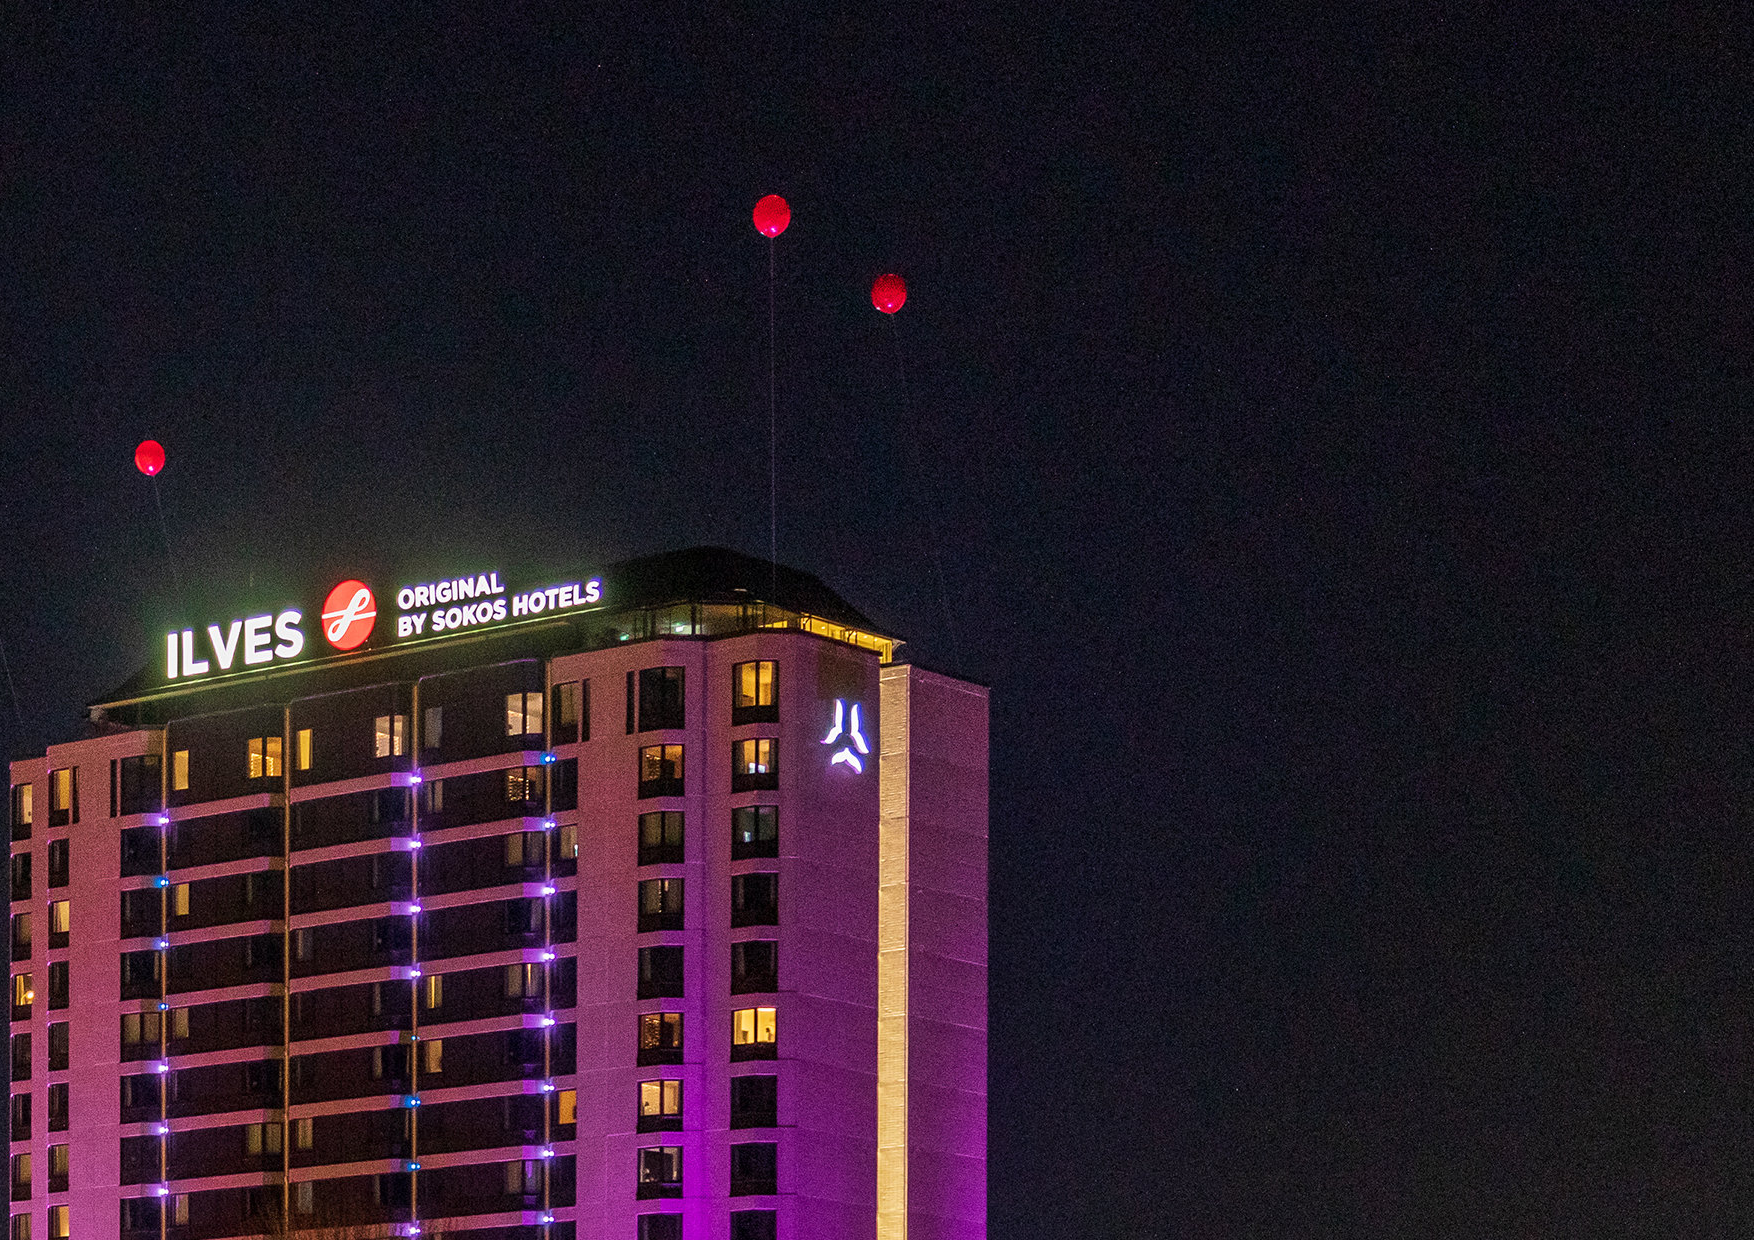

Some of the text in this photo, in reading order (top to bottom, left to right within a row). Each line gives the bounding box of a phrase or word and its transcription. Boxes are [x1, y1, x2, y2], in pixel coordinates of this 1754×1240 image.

[397, 572, 505, 610] ORIGINAL
[397, 580, 601, 637] BY SOKOS HOTELS
[167, 610, 305, 679] ILVES
